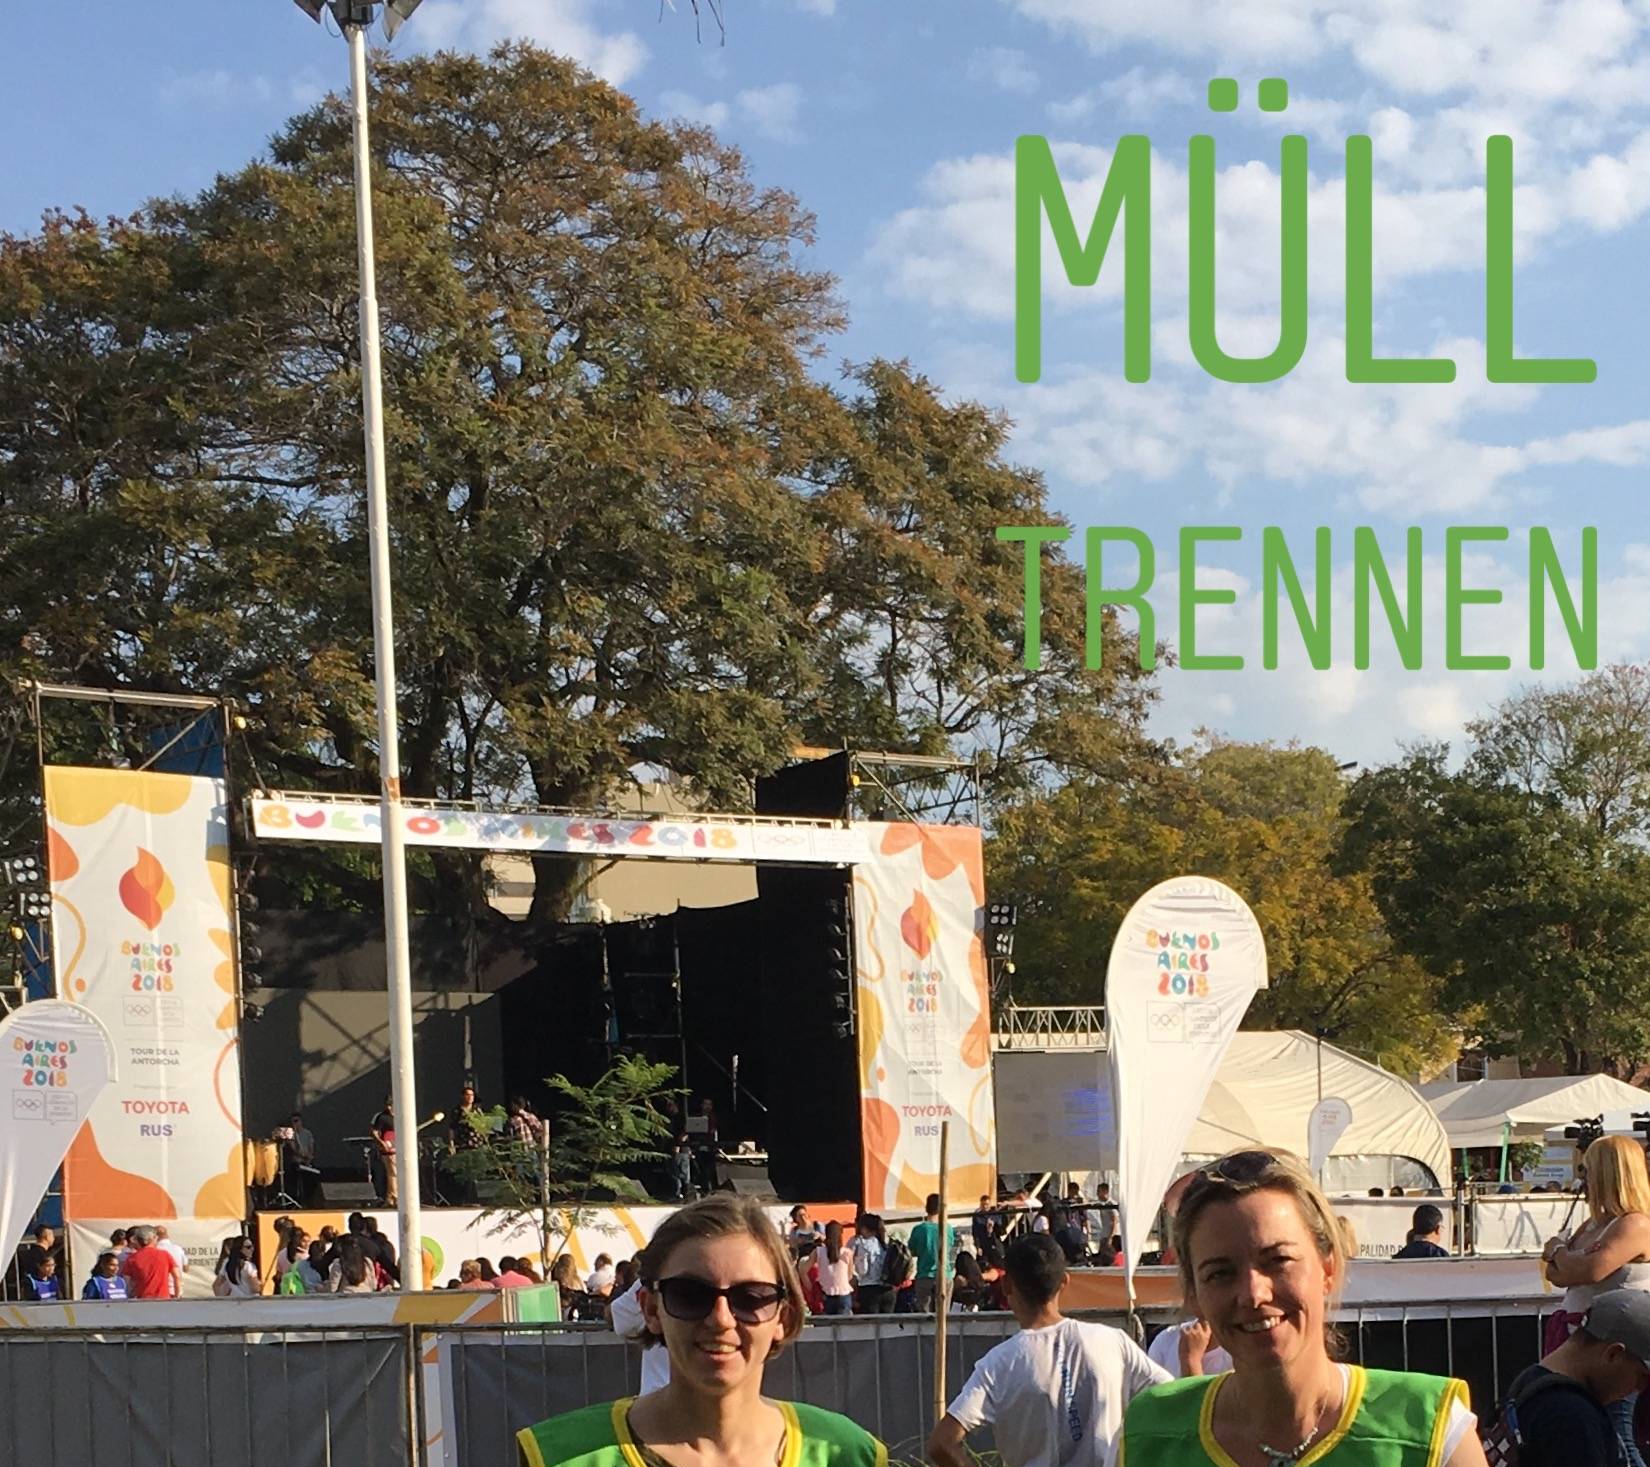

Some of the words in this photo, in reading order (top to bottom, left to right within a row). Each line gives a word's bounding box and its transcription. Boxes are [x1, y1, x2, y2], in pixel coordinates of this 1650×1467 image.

[629, 824, 738, 849] 2018
[1146, 929, 1220, 950] BUENOS
[121, 941, 181, 956] BUENOS
[130, 958, 173, 974] AIRES
[1157, 950, 1209, 972] AIRES
[132, 974, 174, 992] 2018
[1158, 973, 1210, 997] 2018
[908, 997, 938, 1012] 2018
[13, 1037, 77, 1054] BUENOS
[169, 1048, 180, 1056] LA
[22, 1053, 68, 1070] AIRES
[23, 1069, 68, 1087] 2018
[122, 1100, 190, 1114] TOYOTA
[902, 1106, 952, 1118] TOYOTA
[140, 1125, 173, 1137] RUS
[914, 1125, 939, 1137] RUS
[1360, 1243, 1396, 1257] PALIDAD
